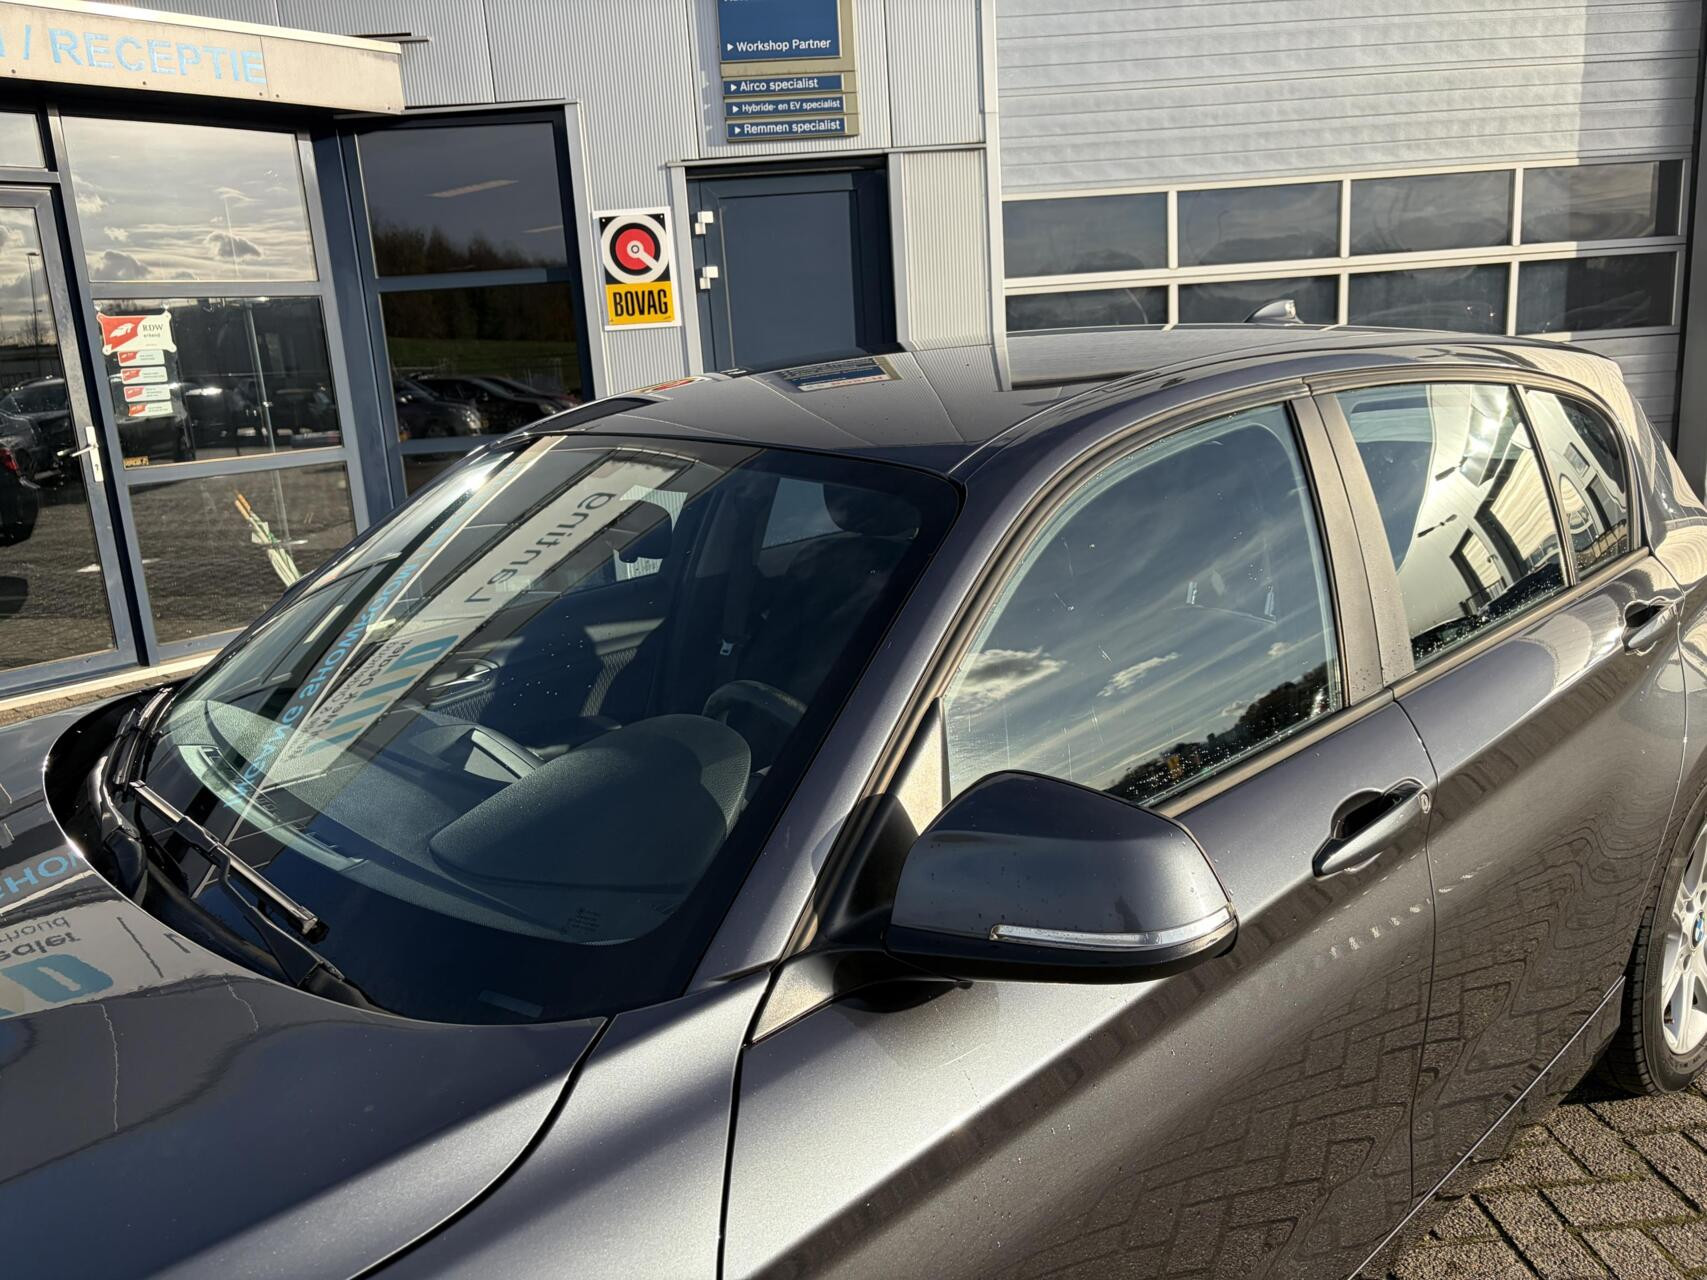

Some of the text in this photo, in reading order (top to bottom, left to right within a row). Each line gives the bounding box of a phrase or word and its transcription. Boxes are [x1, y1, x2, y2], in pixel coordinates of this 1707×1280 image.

[736, 39, 831, 52] Workshop Partner
[48, 27, 267, 84] RECEPTIE
[740, 78, 818, 91] Airco specialist
[790, 101, 801, 110] EV
[802, 99, 841, 110] specialist
[744, 120, 841, 134] Remmen specialist
[613, 289, 668, 317] BOVAG
